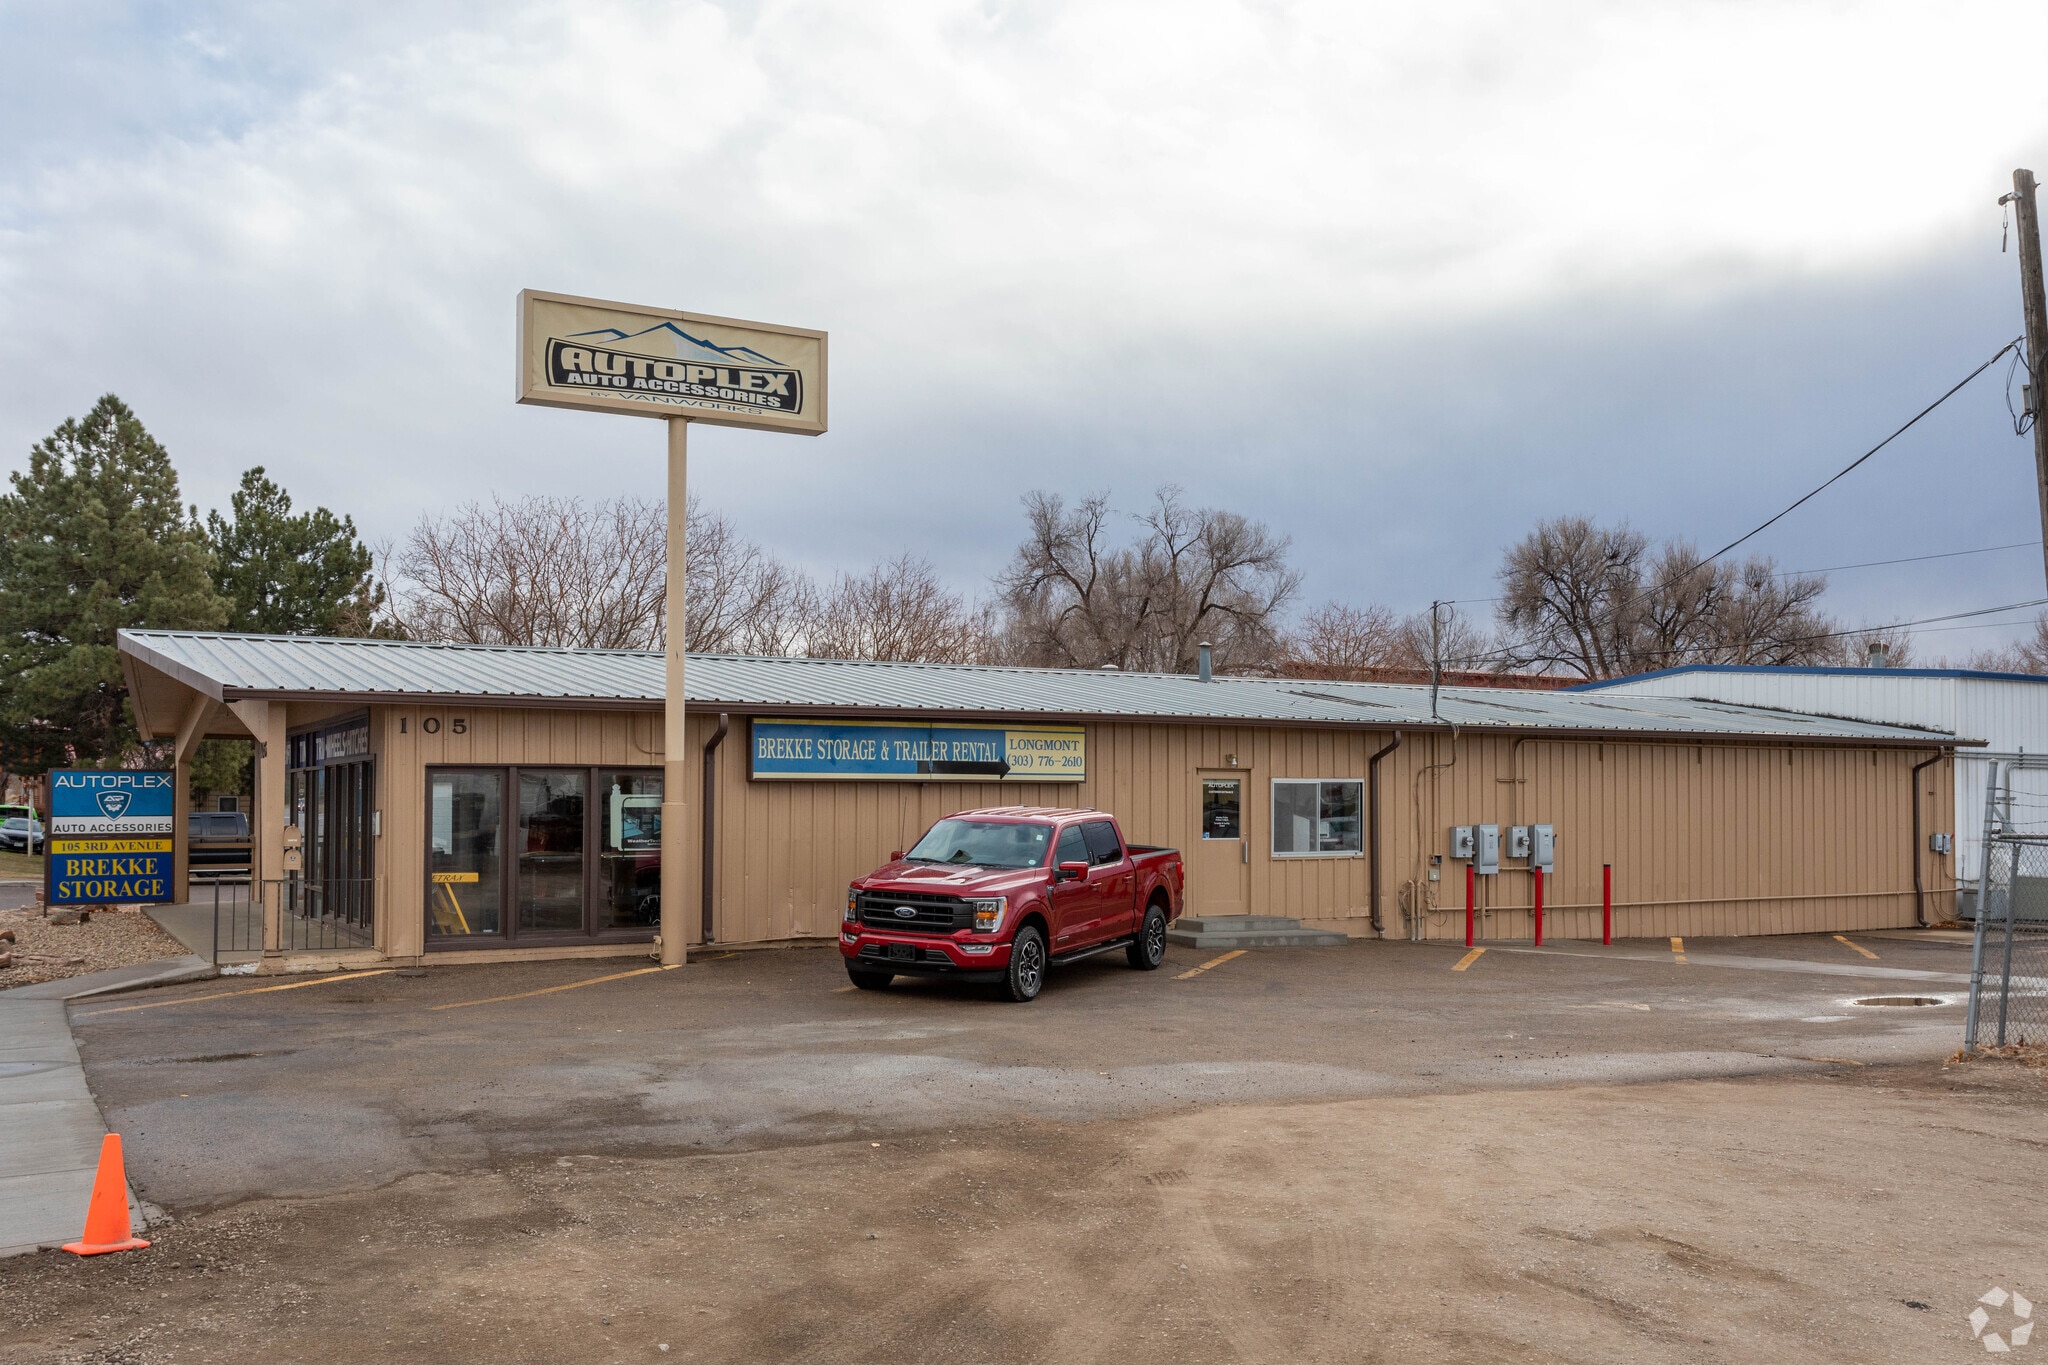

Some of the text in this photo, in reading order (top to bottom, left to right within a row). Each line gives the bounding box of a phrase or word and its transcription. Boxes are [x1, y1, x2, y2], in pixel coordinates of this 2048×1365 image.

[561, 347, 789, 396] AUTOPLEX
[566, 372, 782, 409] AUTO ACCESSORIES
[589, 391, 763, 415] BY VANWORKS
[400, 717, 468, 734] 105
[757, 737, 1000, 763] BREKKE STORAGE & TRAILER RENTAL
[1009, 738, 1080, 752] LONGMONT
[1006, 755, 1083, 769] (303) 776-2610
[55, 776, 171, 787] AUTOPLEX
[53, 823, 172, 833] AUTO ACCESSORIES
[61, 841, 163, 852] 105 3RD AVENUE
[66, 858, 158, 877] BREKKE
[58, 879, 164, 899] STORAGE
